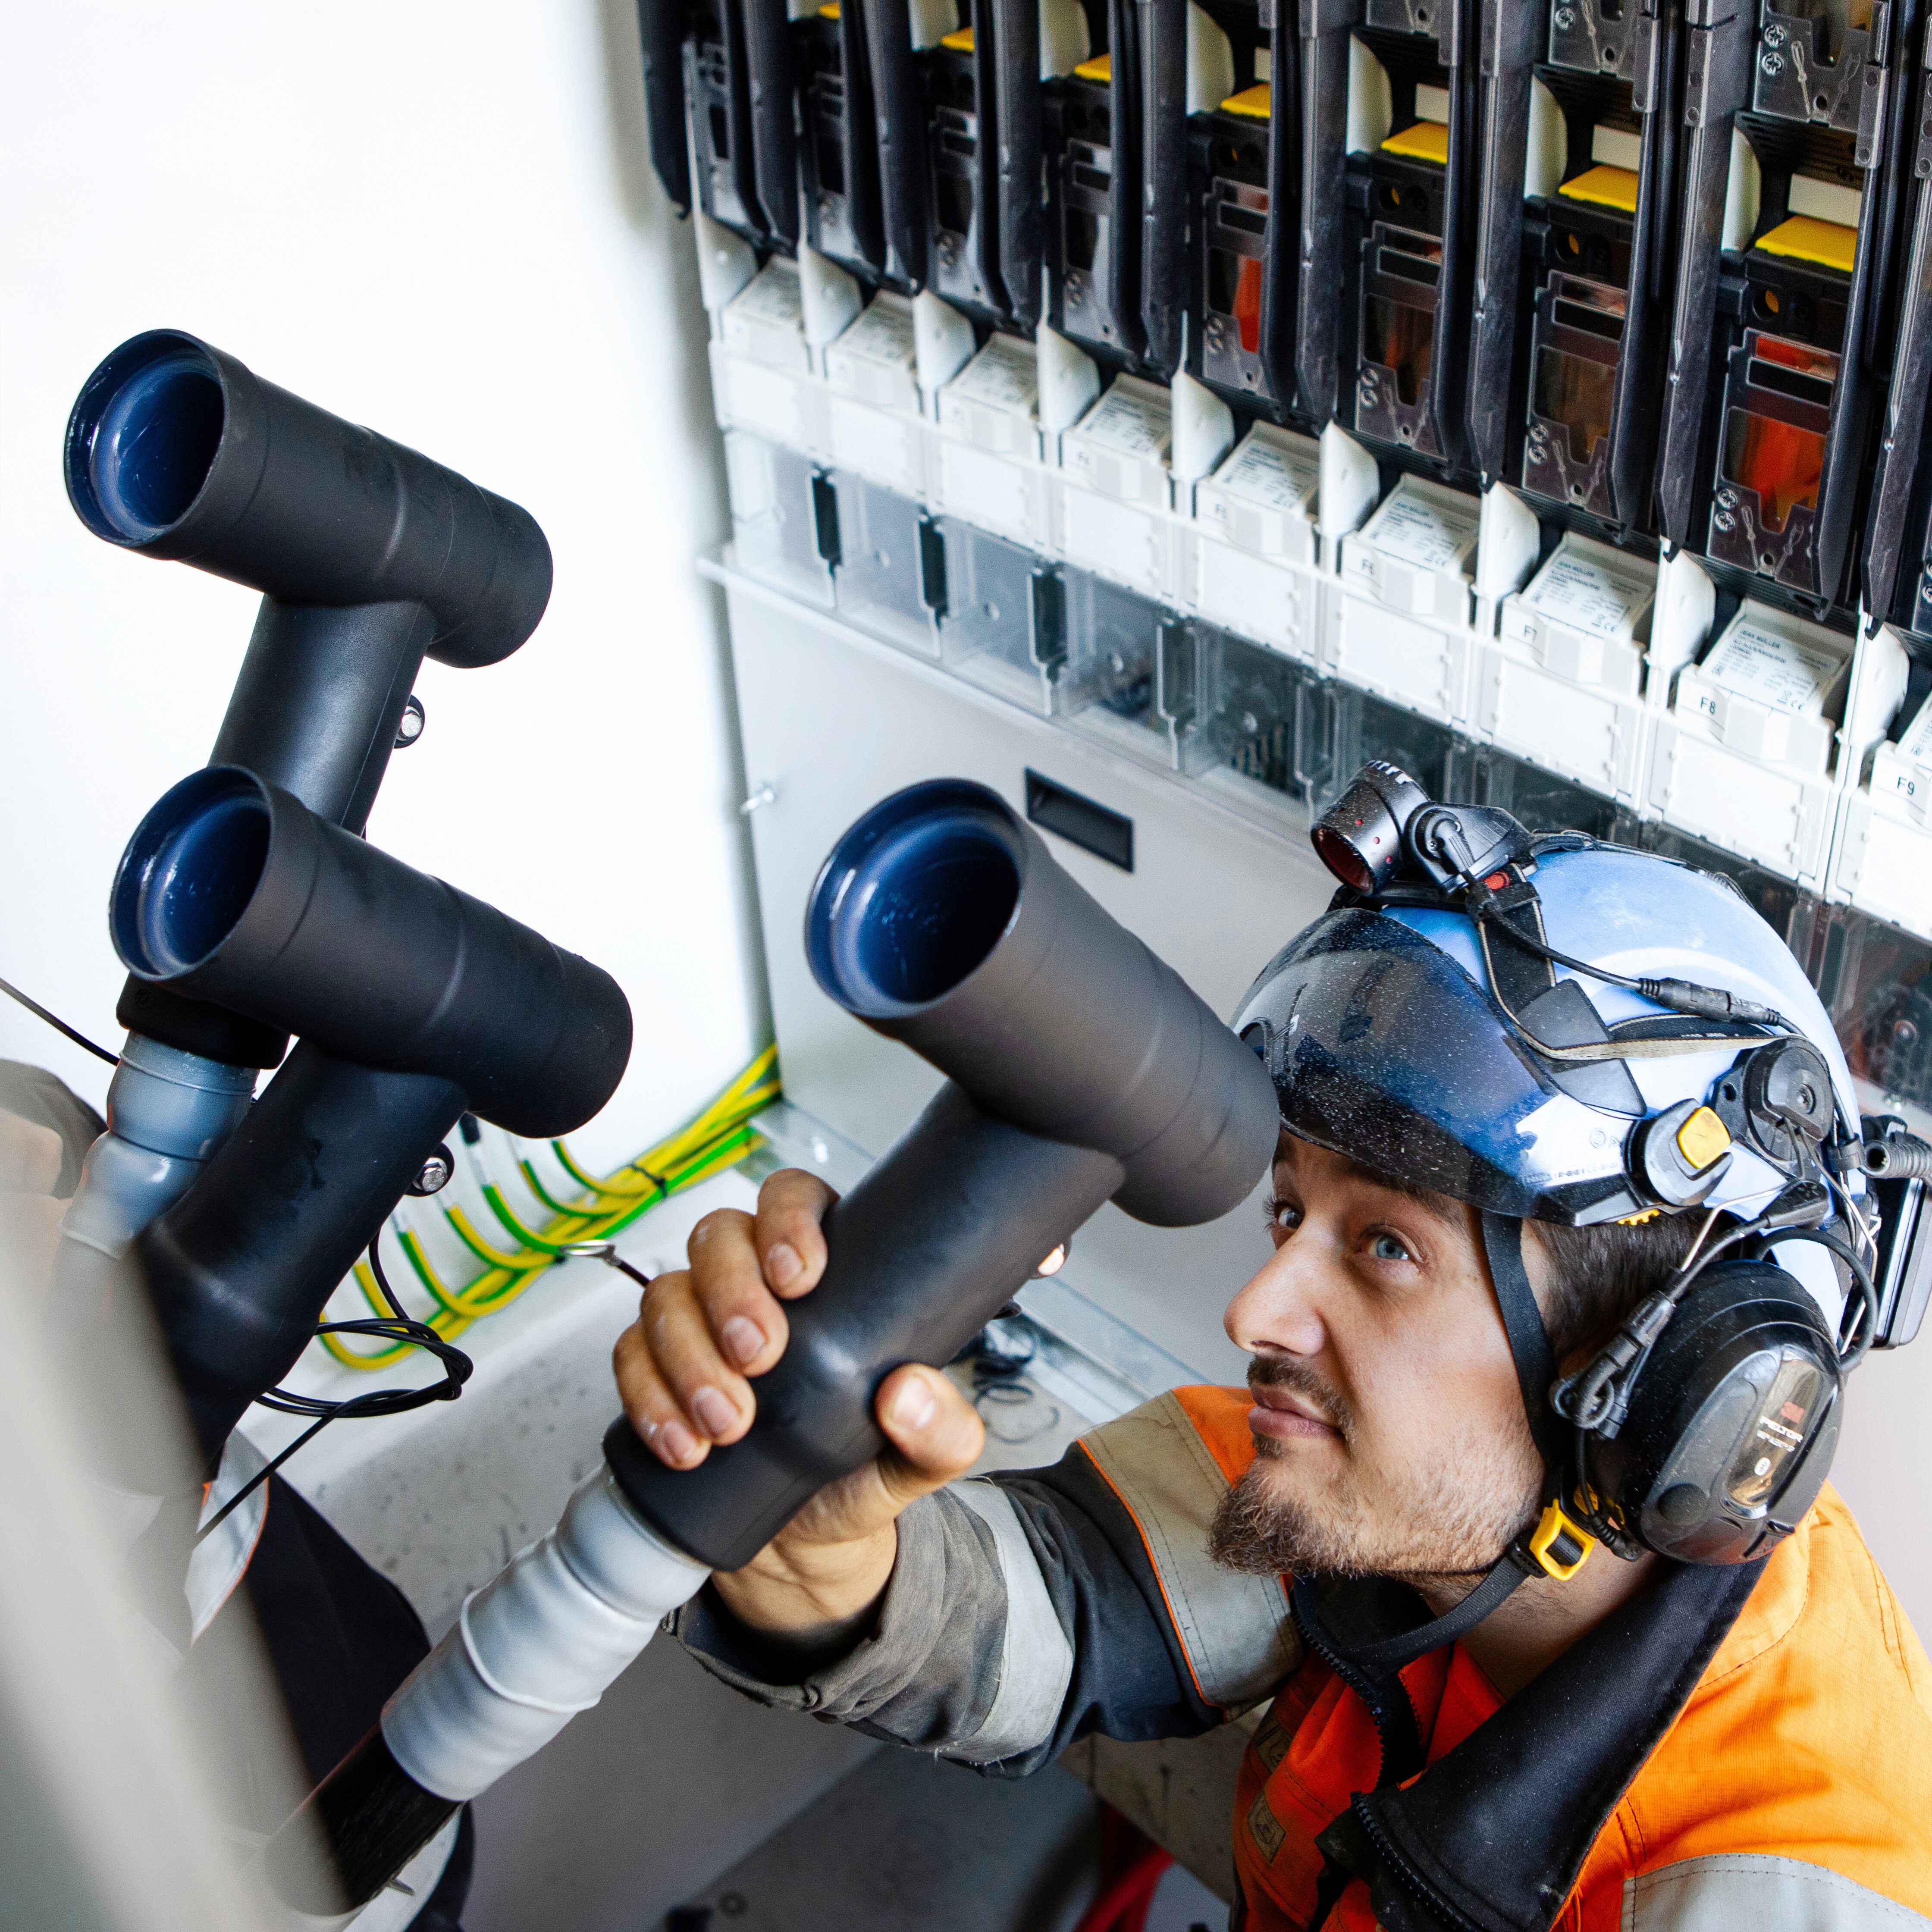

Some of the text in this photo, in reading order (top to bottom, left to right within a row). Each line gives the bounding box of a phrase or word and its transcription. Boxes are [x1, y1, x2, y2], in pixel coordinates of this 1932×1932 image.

[1700, 696, 1716, 715] F8
[1897, 776, 1915, 796] F9
[1759, 1414, 1804, 1443] PELTOR
